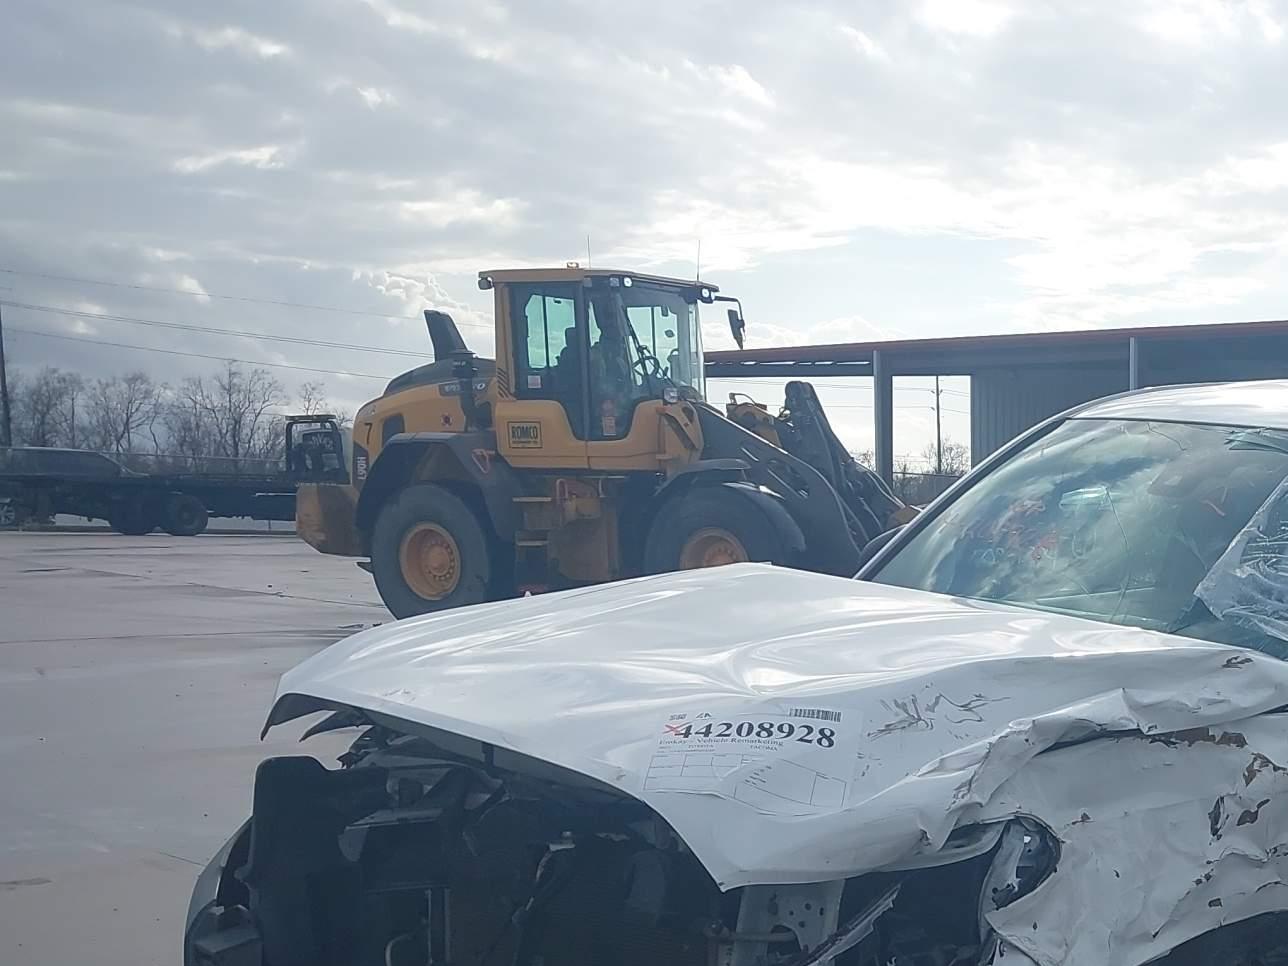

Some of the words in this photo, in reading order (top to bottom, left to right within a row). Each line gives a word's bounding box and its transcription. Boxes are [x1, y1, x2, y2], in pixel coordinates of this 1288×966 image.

[363, 422, 373, 445] 7
[356, 456, 367, 480] L90H
[674, 721, 836, 748] 44208928
[730, 738, 784, 746] Remarketing
